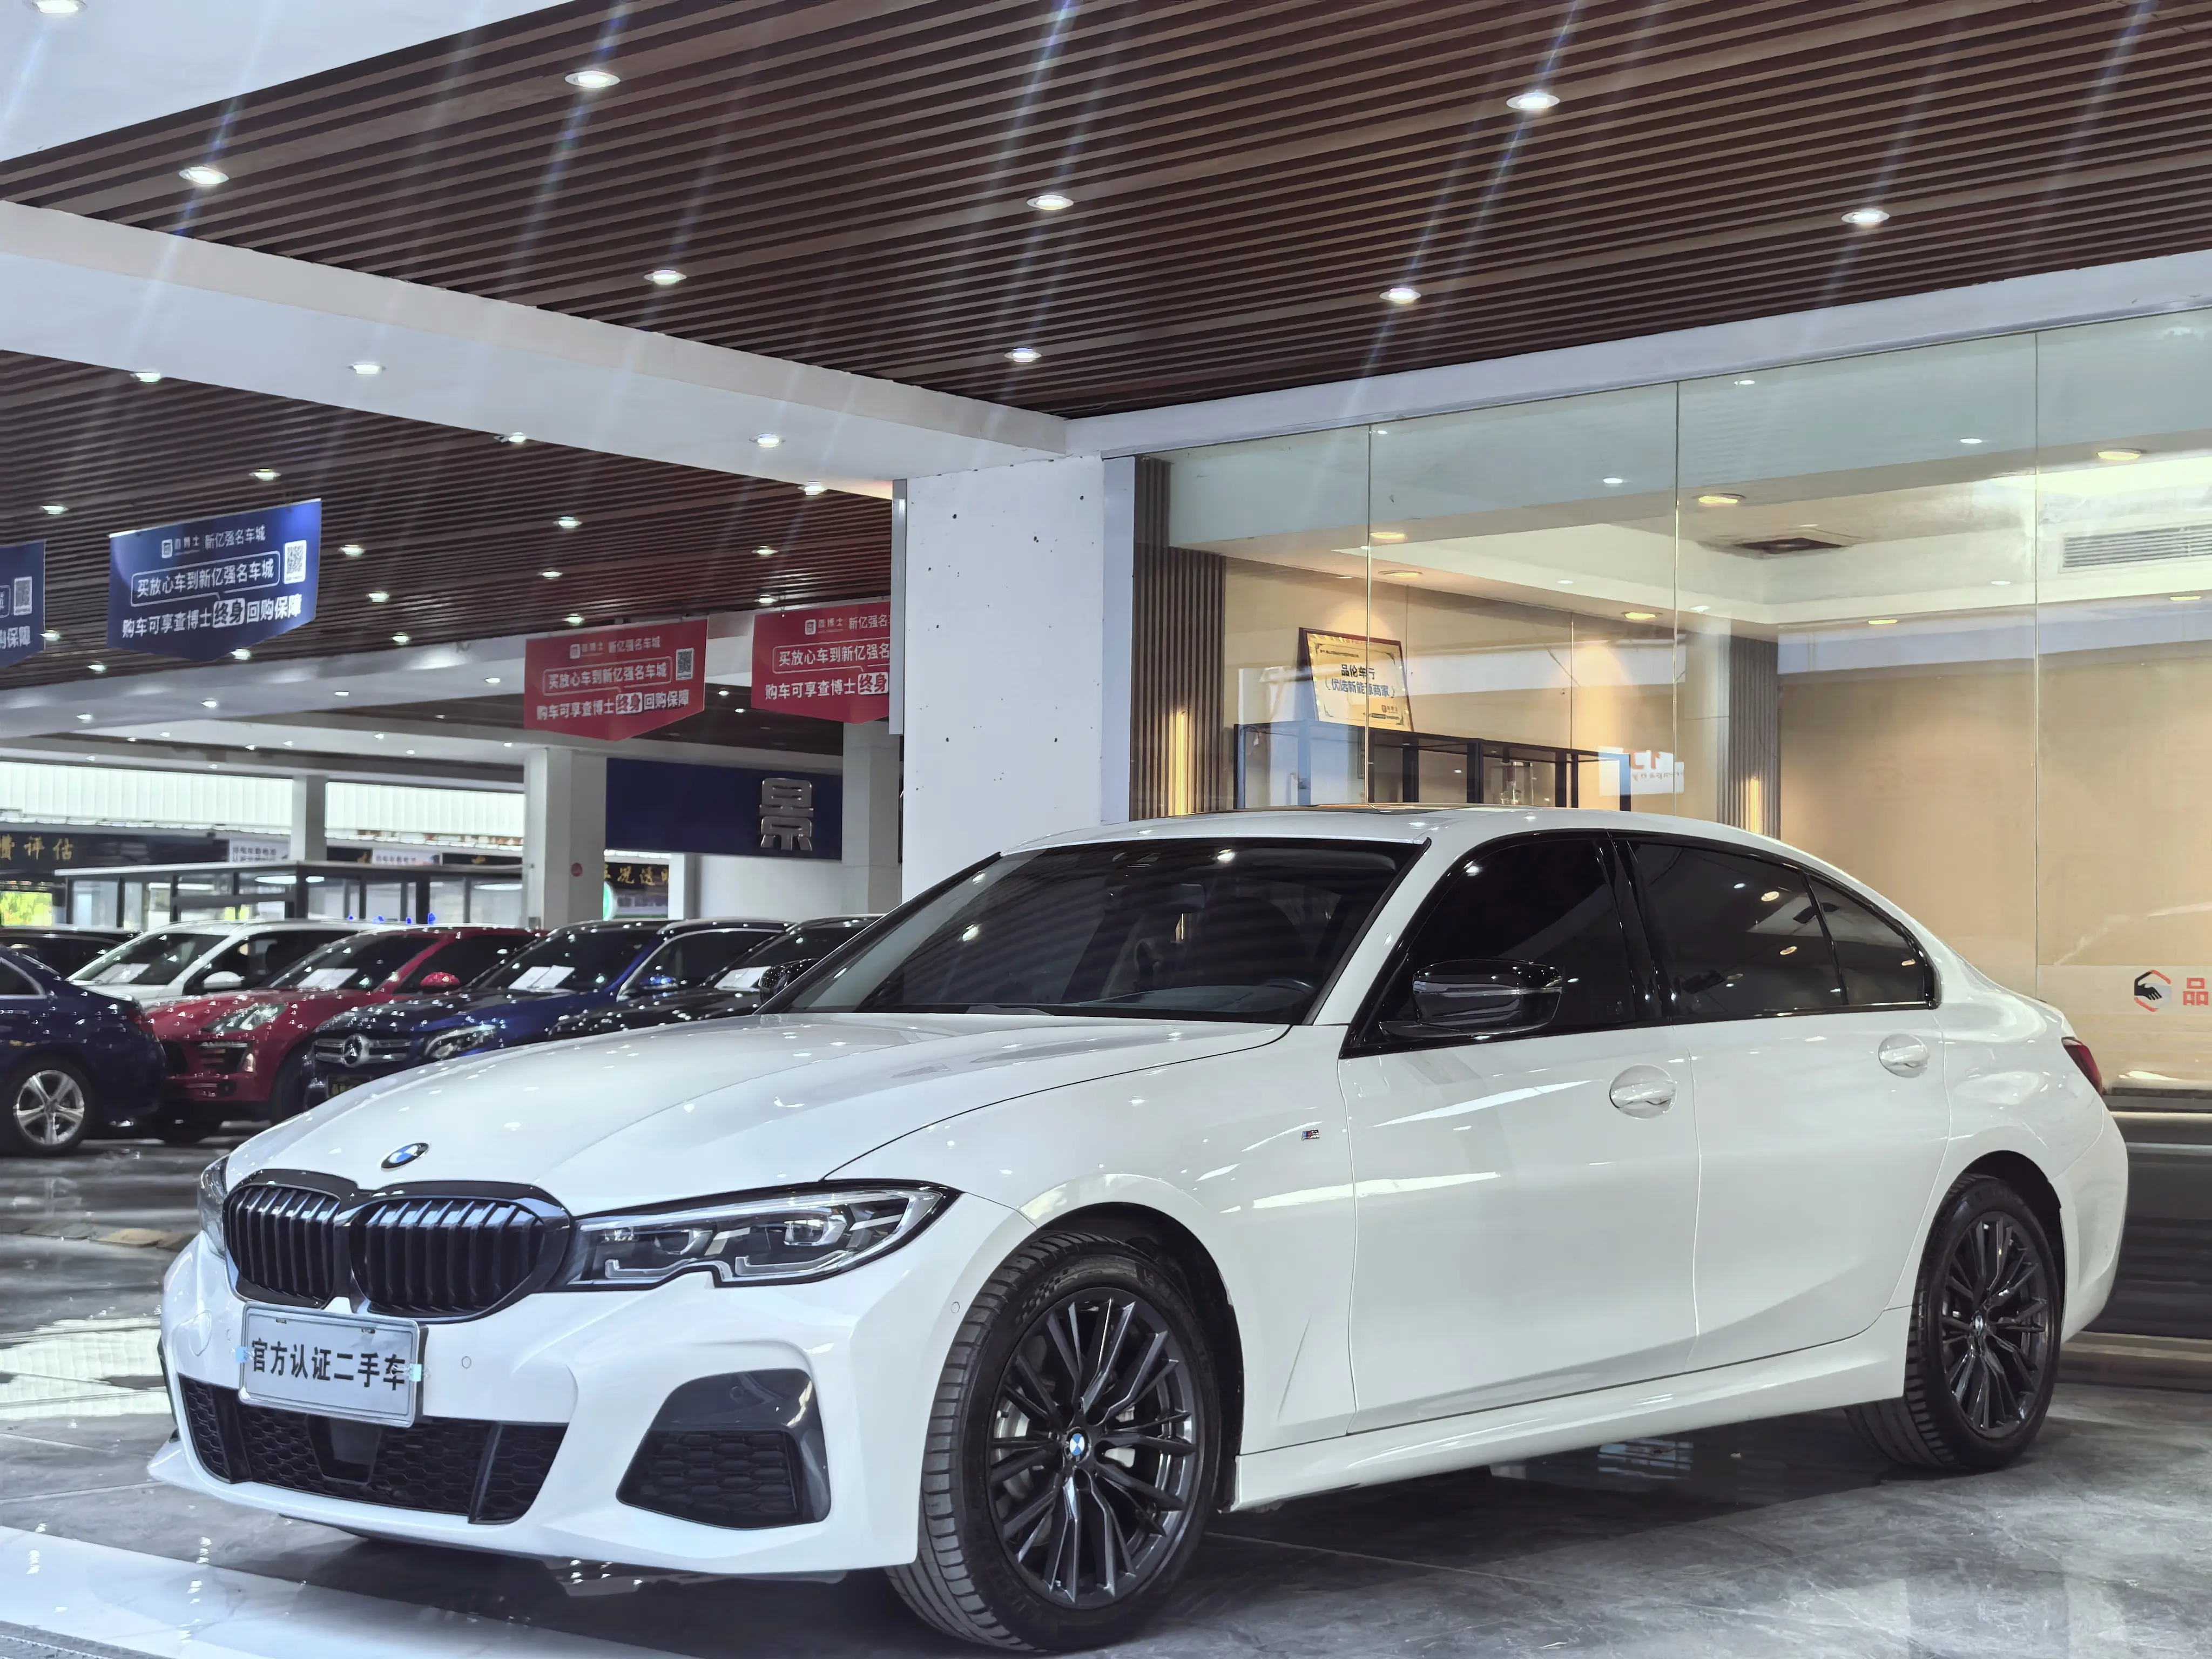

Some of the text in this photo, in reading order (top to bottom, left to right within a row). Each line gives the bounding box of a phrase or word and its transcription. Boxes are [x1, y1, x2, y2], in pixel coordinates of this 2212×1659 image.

[137, 558, 274, 598] 买放心车到新亿强名车城
[122, 594, 302, 638] 购车可享查博士终身回购保障
[848, 614, 890, 630] 新亿强名
[779, 643, 890, 667] 买放心车到新亿强名
[548, 662, 667, 690] 买放心车到新亿强名车城
[765, 673, 888, 700] 购车可享查博士终身
[536, 689, 690, 720] 购车可享查博士终身回购保障
[759, 778, 814, 851] 景
[2183, 977, 2208, 1006] 品
[252, 1338, 406, 1391] 官方认证二手车
